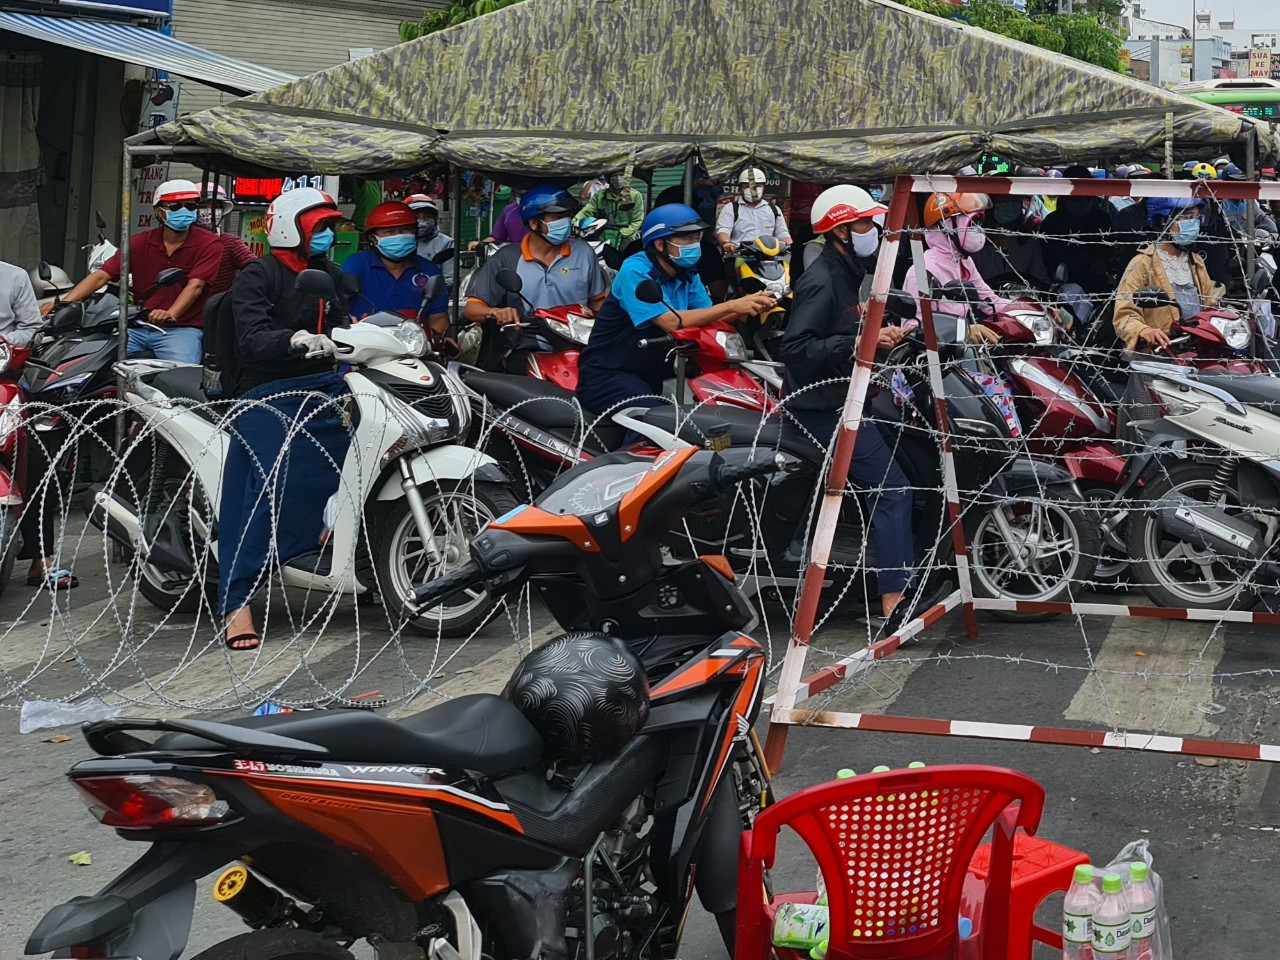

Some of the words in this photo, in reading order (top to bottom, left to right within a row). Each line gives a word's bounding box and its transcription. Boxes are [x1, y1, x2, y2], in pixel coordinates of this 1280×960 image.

[140, 191, 153, 204] TR
[138, 215, 152, 228] EM
[503, 416, 570, 454] SIRIUS
[266, 762, 341, 778] YOSHIMURA
